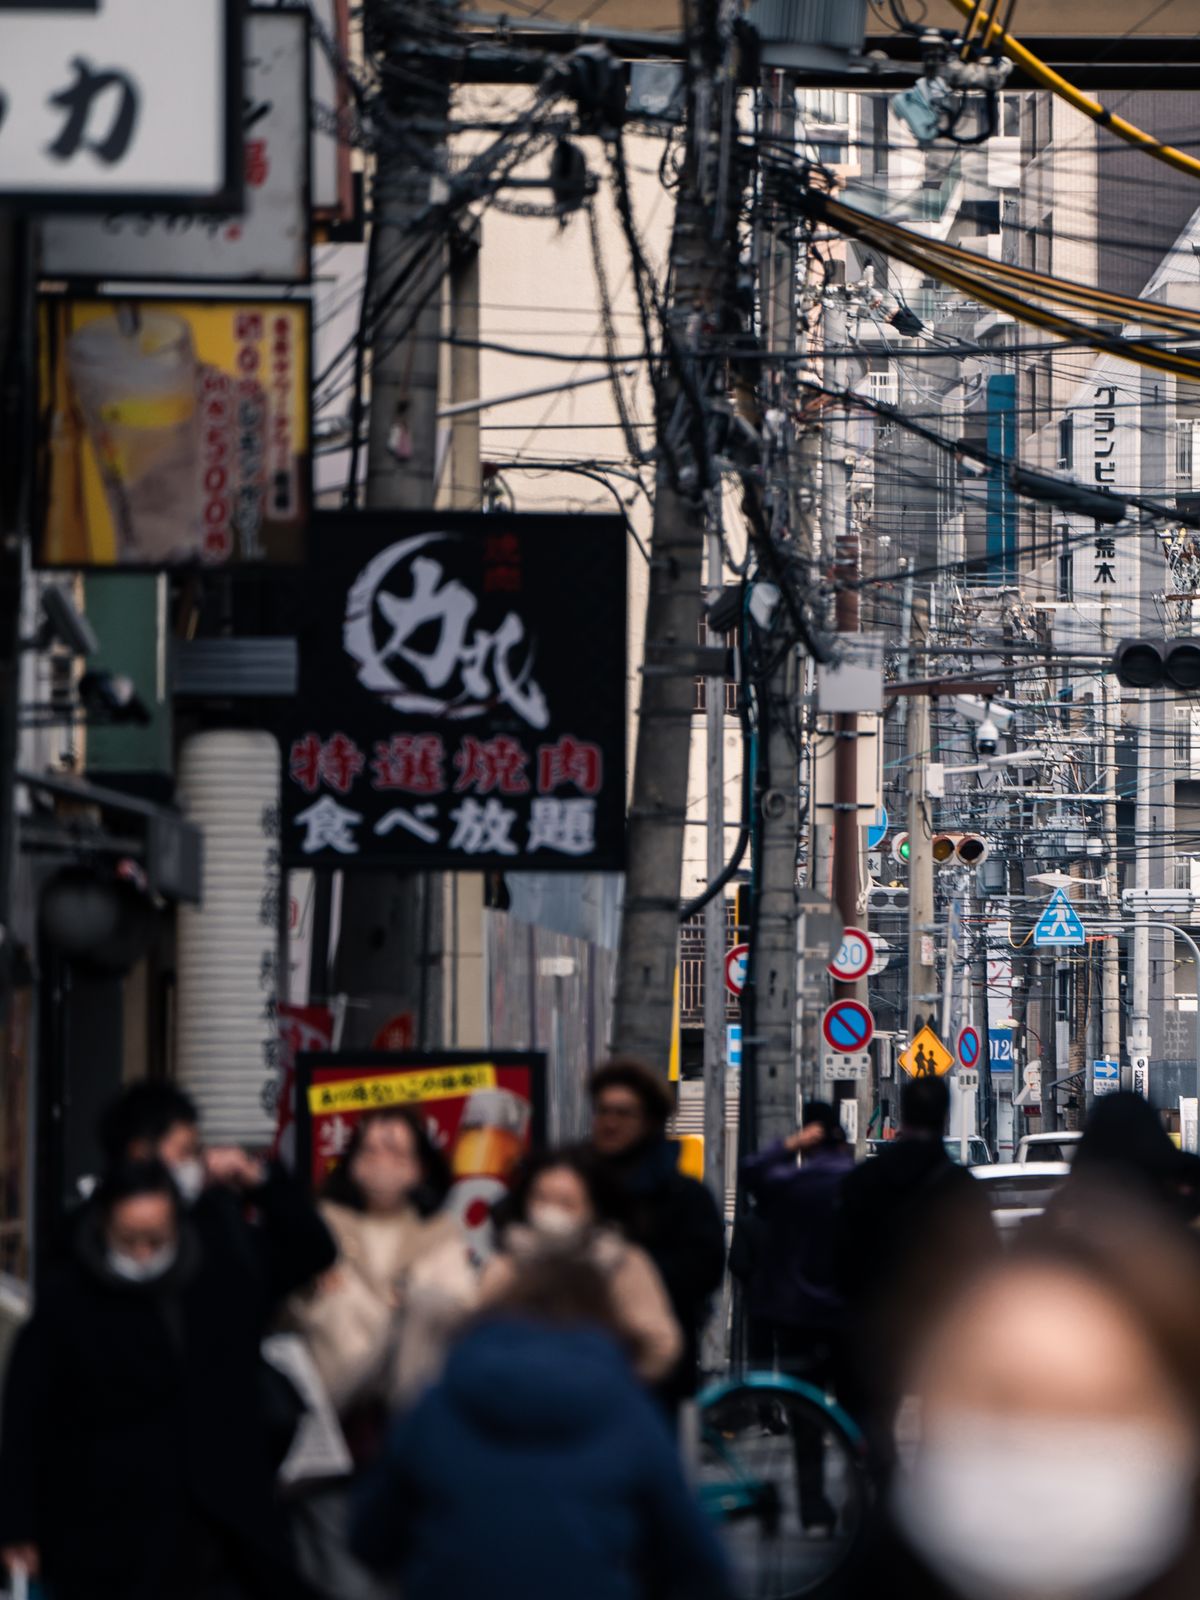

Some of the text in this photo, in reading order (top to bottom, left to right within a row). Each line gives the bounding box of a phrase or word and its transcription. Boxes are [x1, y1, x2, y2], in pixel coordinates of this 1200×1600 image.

[290, 733, 603, 794] 特選焼肉
[295, 795, 597, 855] 食べ放題
[836, 943, 862, 966] 30
